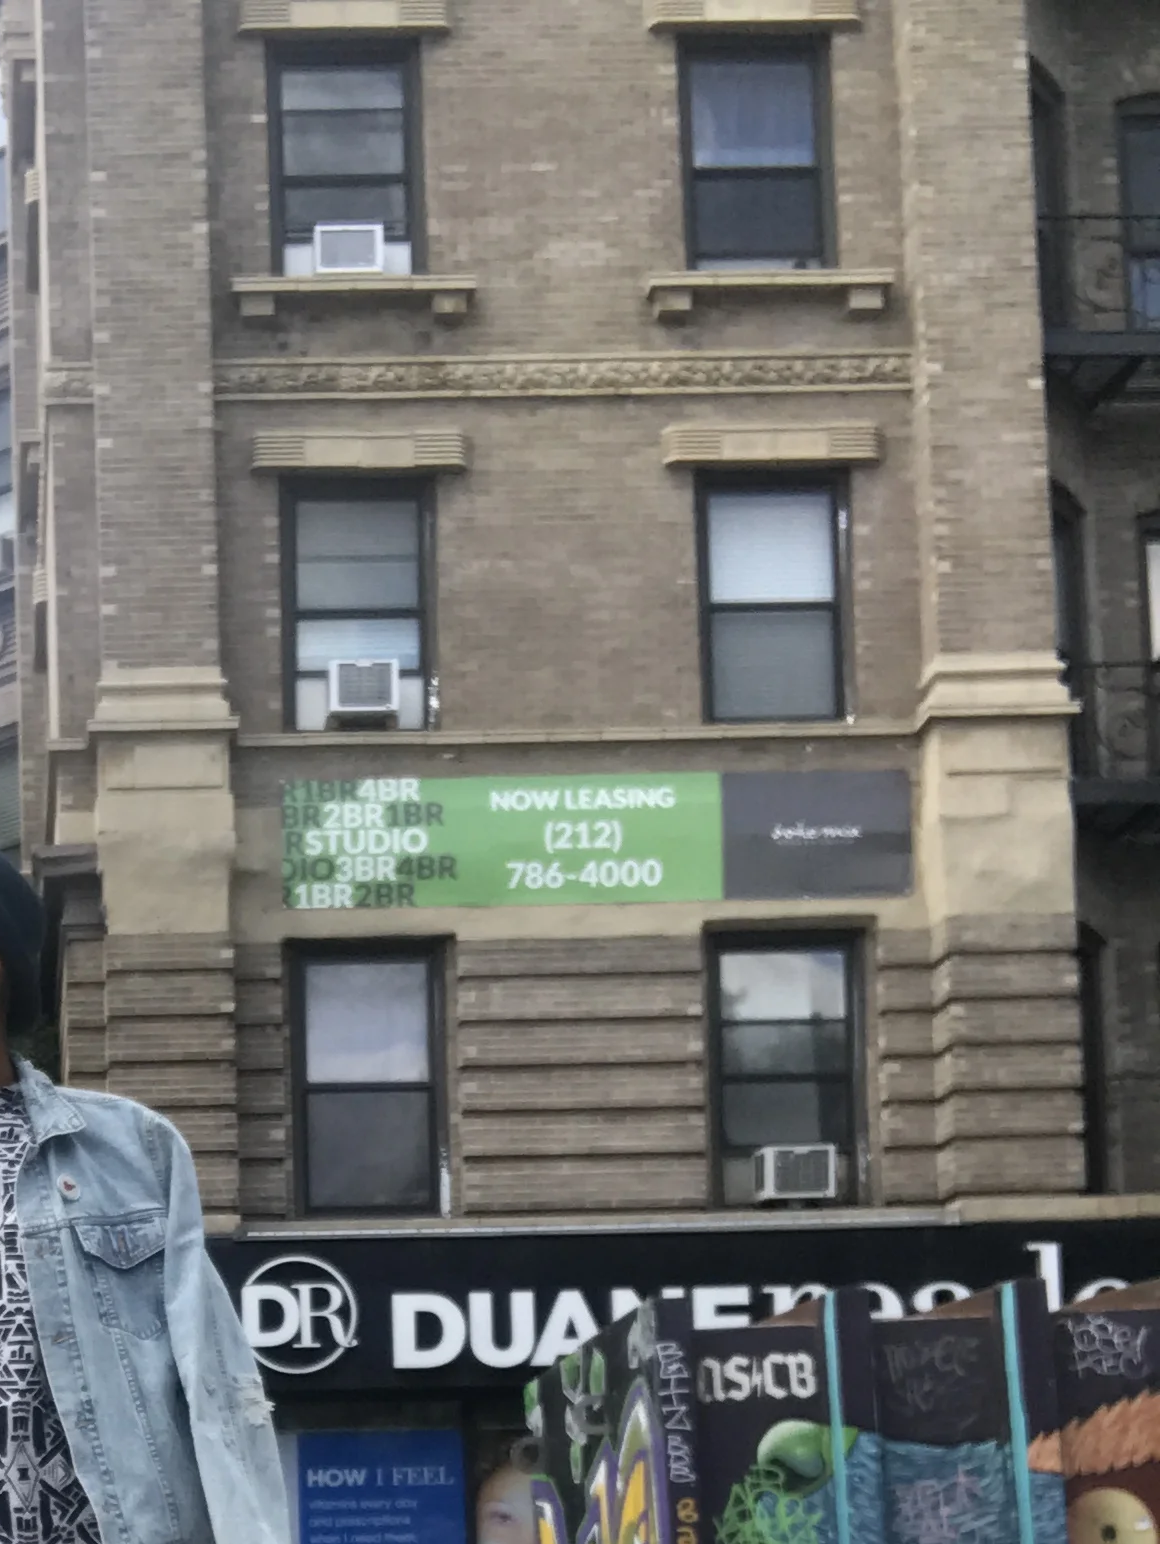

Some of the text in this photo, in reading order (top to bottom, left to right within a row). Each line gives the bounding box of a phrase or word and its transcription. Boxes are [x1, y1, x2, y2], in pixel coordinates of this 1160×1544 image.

[490, 787, 676, 811] NOW LEASING
[305, 828, 428, 855] STUDIO
[544, 820, 623, 854] (212)
[506, 858, 662, 889] 786-4000
[241, 1283, 751, 1369] DR DUAE
[307, 1466, 454, 1487] HOW I FEEL
